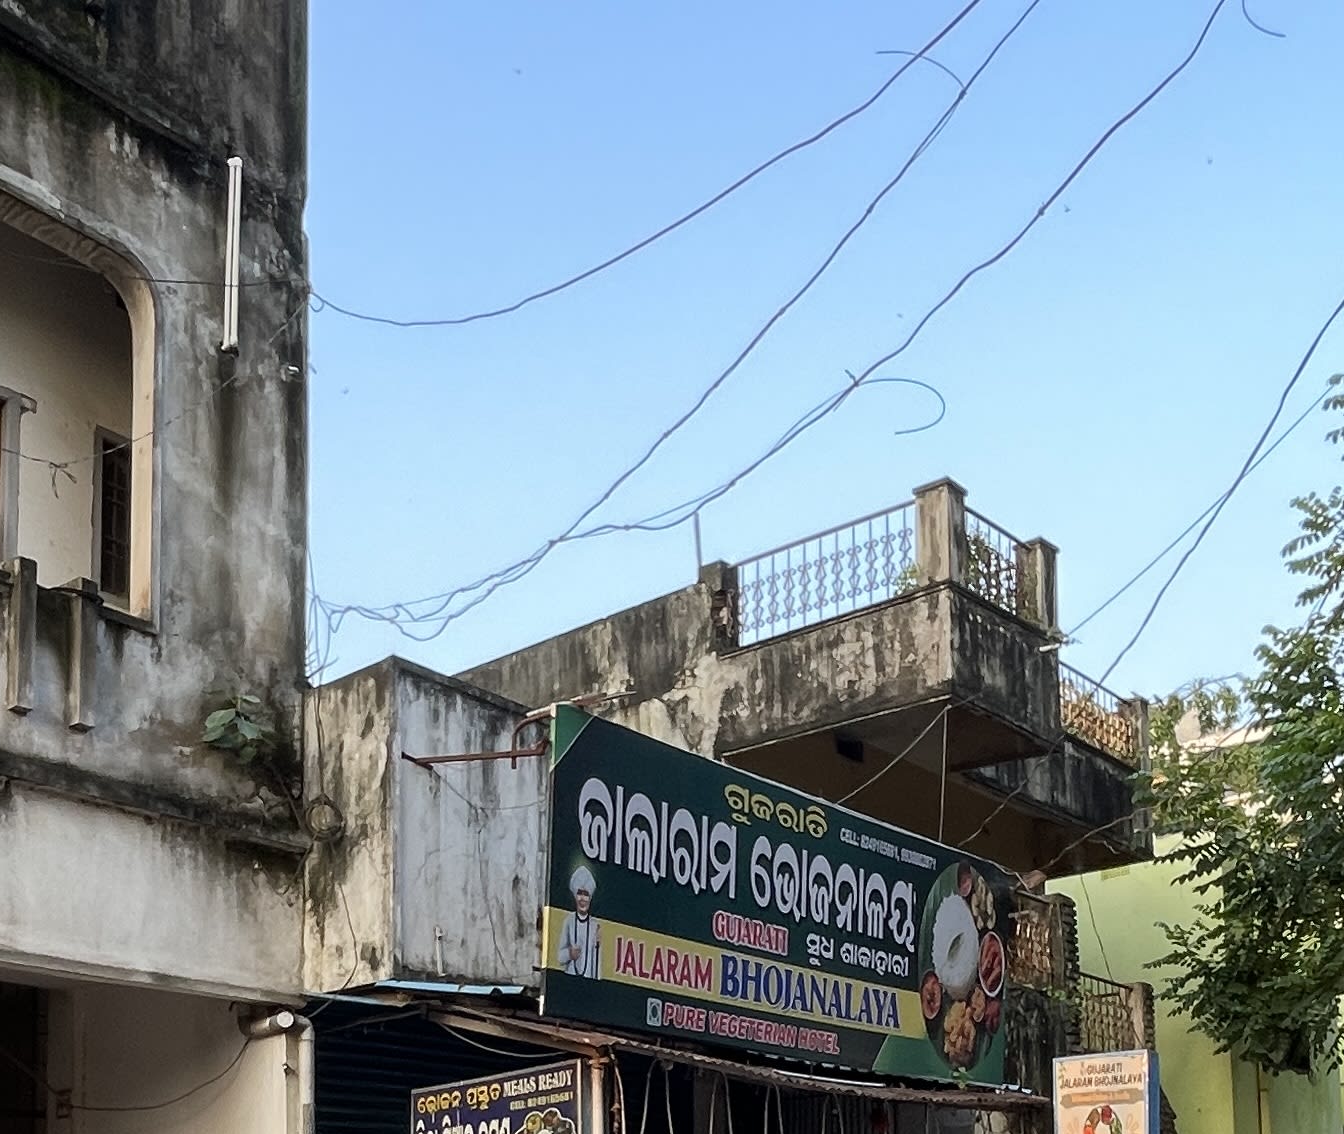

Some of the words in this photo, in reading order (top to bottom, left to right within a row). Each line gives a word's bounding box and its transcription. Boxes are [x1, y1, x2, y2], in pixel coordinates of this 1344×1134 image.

[578, 777, 737, 899] ଜାଲାରାମ
[712, 910, 789, 956] GUJARATI
[615, 937, 713, 993] JALARAM
[719, 953, 901, 1029] BHOJANALAYA
[663, 1002, 706, 1030] PURE
[709, 1010, 798, 1046] VEGETERIAN
[798, 1026, 840, 1054] HOTEL
[503, 1076, 537, 1098] MEALS
[538, 1069, 573, 1091] READY
